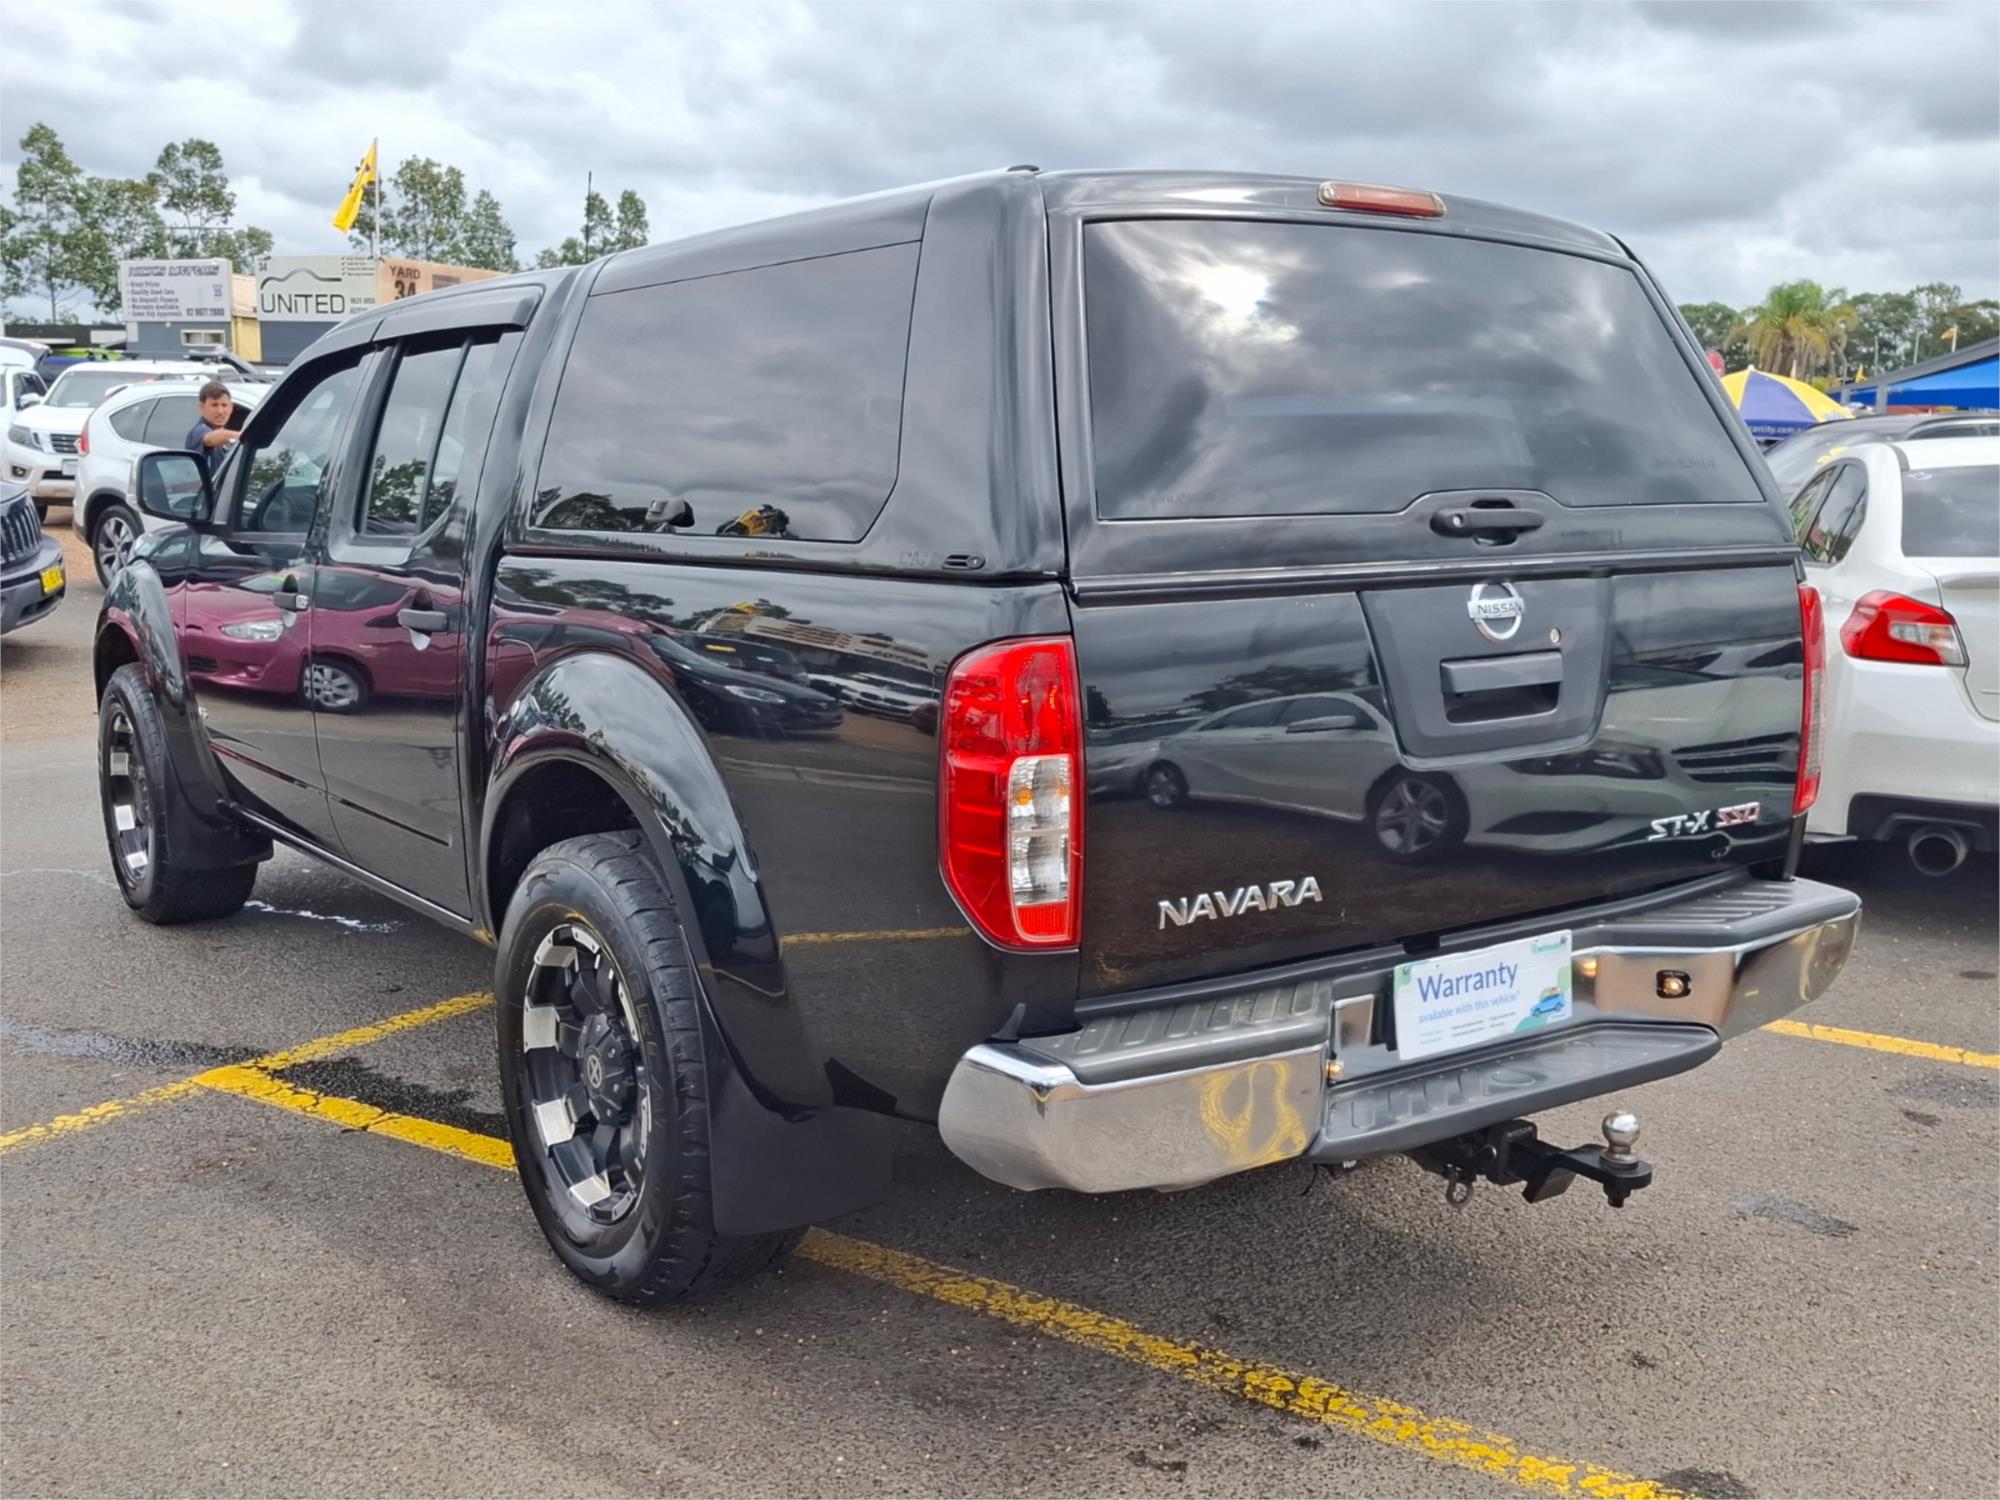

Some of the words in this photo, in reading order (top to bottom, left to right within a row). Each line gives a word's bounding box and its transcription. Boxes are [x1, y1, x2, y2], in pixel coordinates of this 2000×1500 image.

[390, 265, 421, 280] YARD
[394, 279, 417, 300] 34
[260, 293, 346, 314] UNITED
[1476, 602, 1522, 614] NISSAN
[1647, 809, 1711, 842] ST-X
[1158, 875, 1324, 930] NAVARA
[1417, 961, 1519, 1003] Warranty
[1455, 1001, 1473, 1014] with
